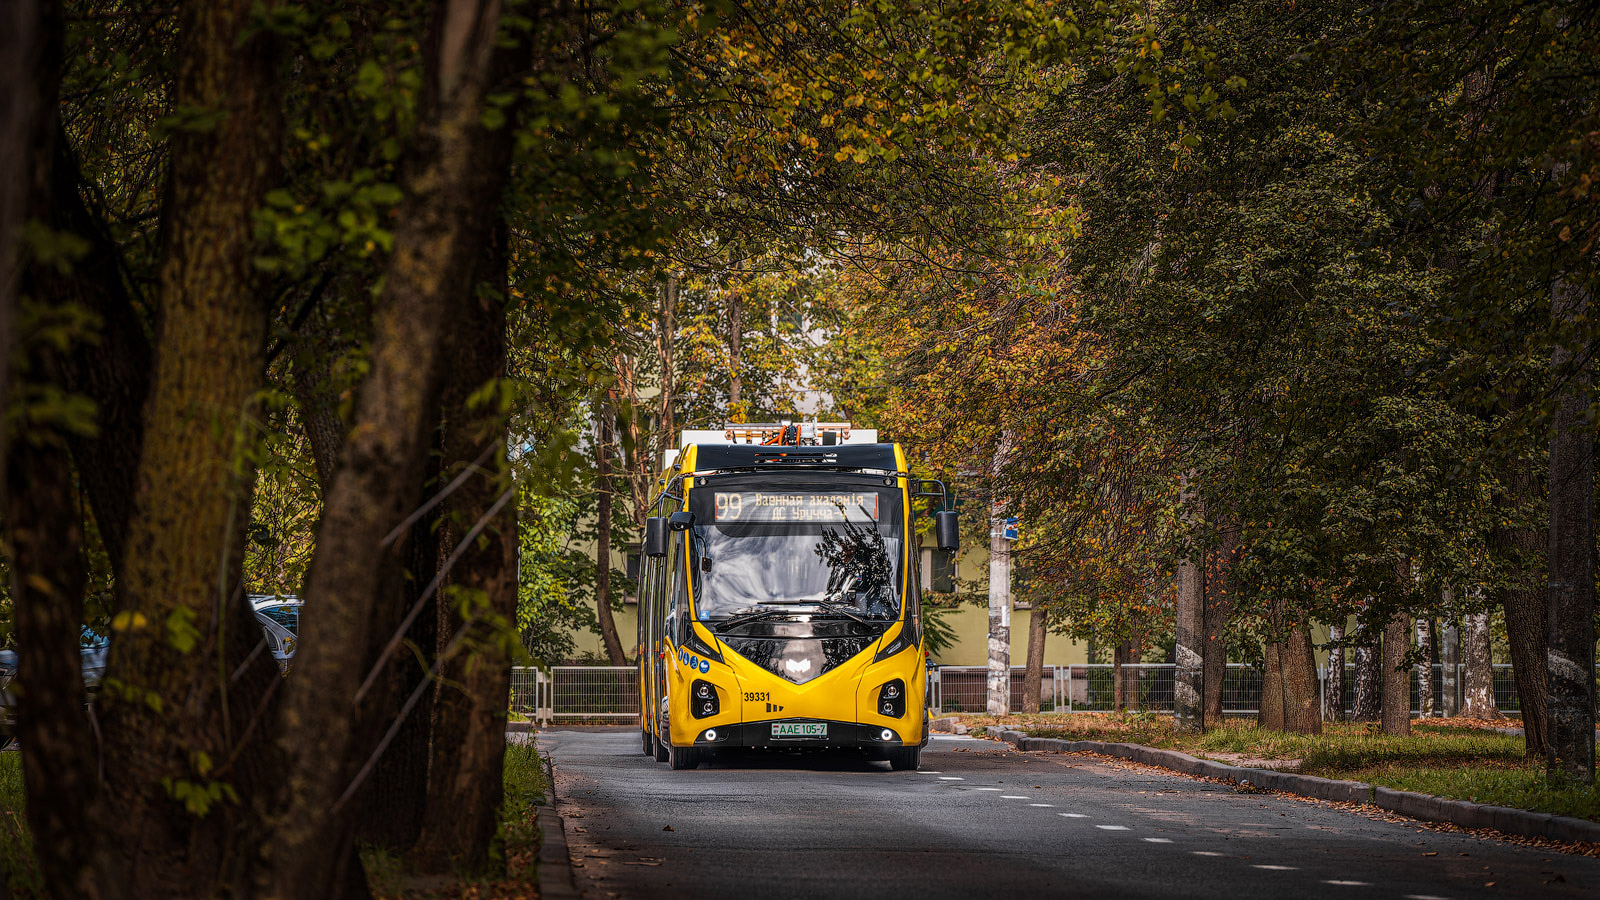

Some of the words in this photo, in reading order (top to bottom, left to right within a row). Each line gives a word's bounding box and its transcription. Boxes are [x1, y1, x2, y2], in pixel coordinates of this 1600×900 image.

[755, 493, 803, 506] Ваенная
[716, 493, 742, 520] 99
[772, 507, 786, 521] ДС
[744, 692, 770, 702] 39331
